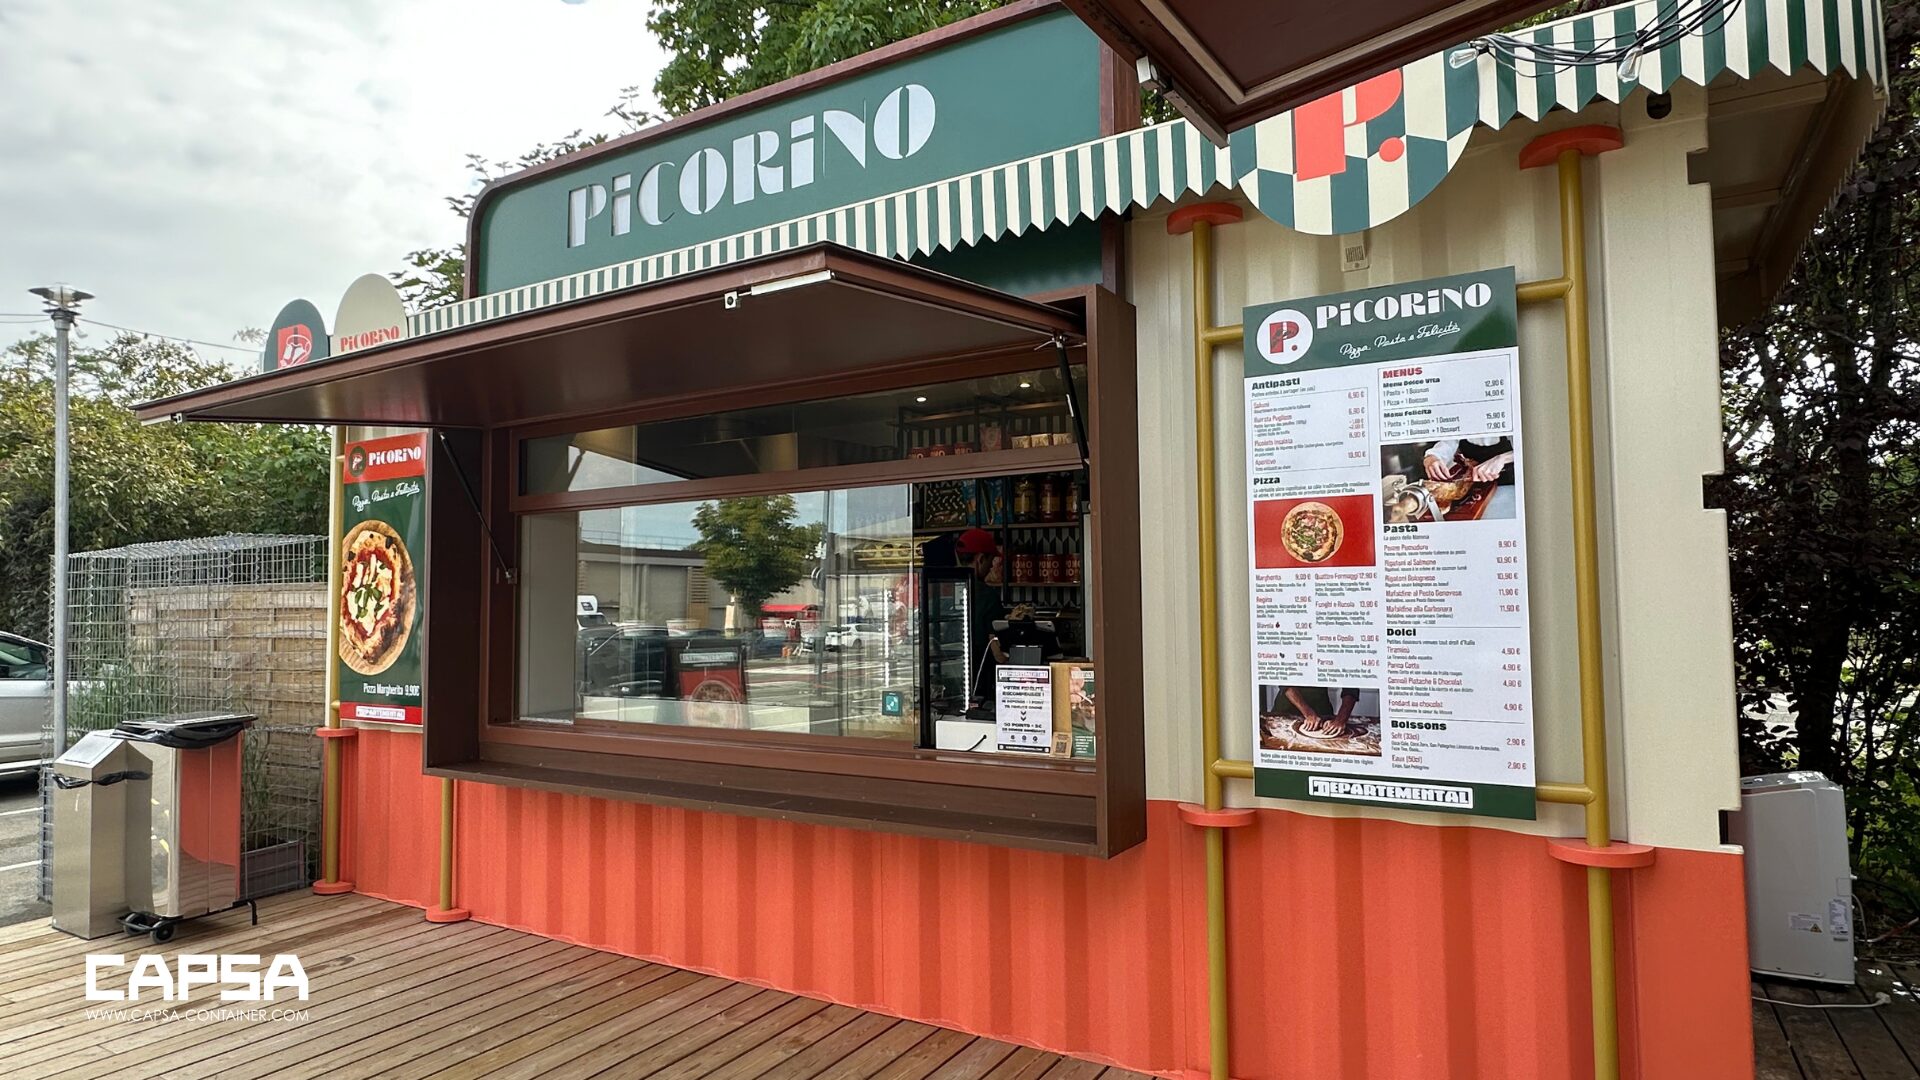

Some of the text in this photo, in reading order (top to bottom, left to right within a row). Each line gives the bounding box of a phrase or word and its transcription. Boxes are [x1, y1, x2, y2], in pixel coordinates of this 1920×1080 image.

[1374, 333, 1406, 347] Pasta
[1383, 367, 1422, 378] MENUS
[1252, 377, 1300, 390] Antipasti
[1253, 477, 1280, 485] Pizza
[1383, 524, 1418, 533] Pasta
[1387, 628, 1416, 636] Dolci
[376, 683, 404, 697] Margherita
[1391, 720, 1447, 731] Boissons
